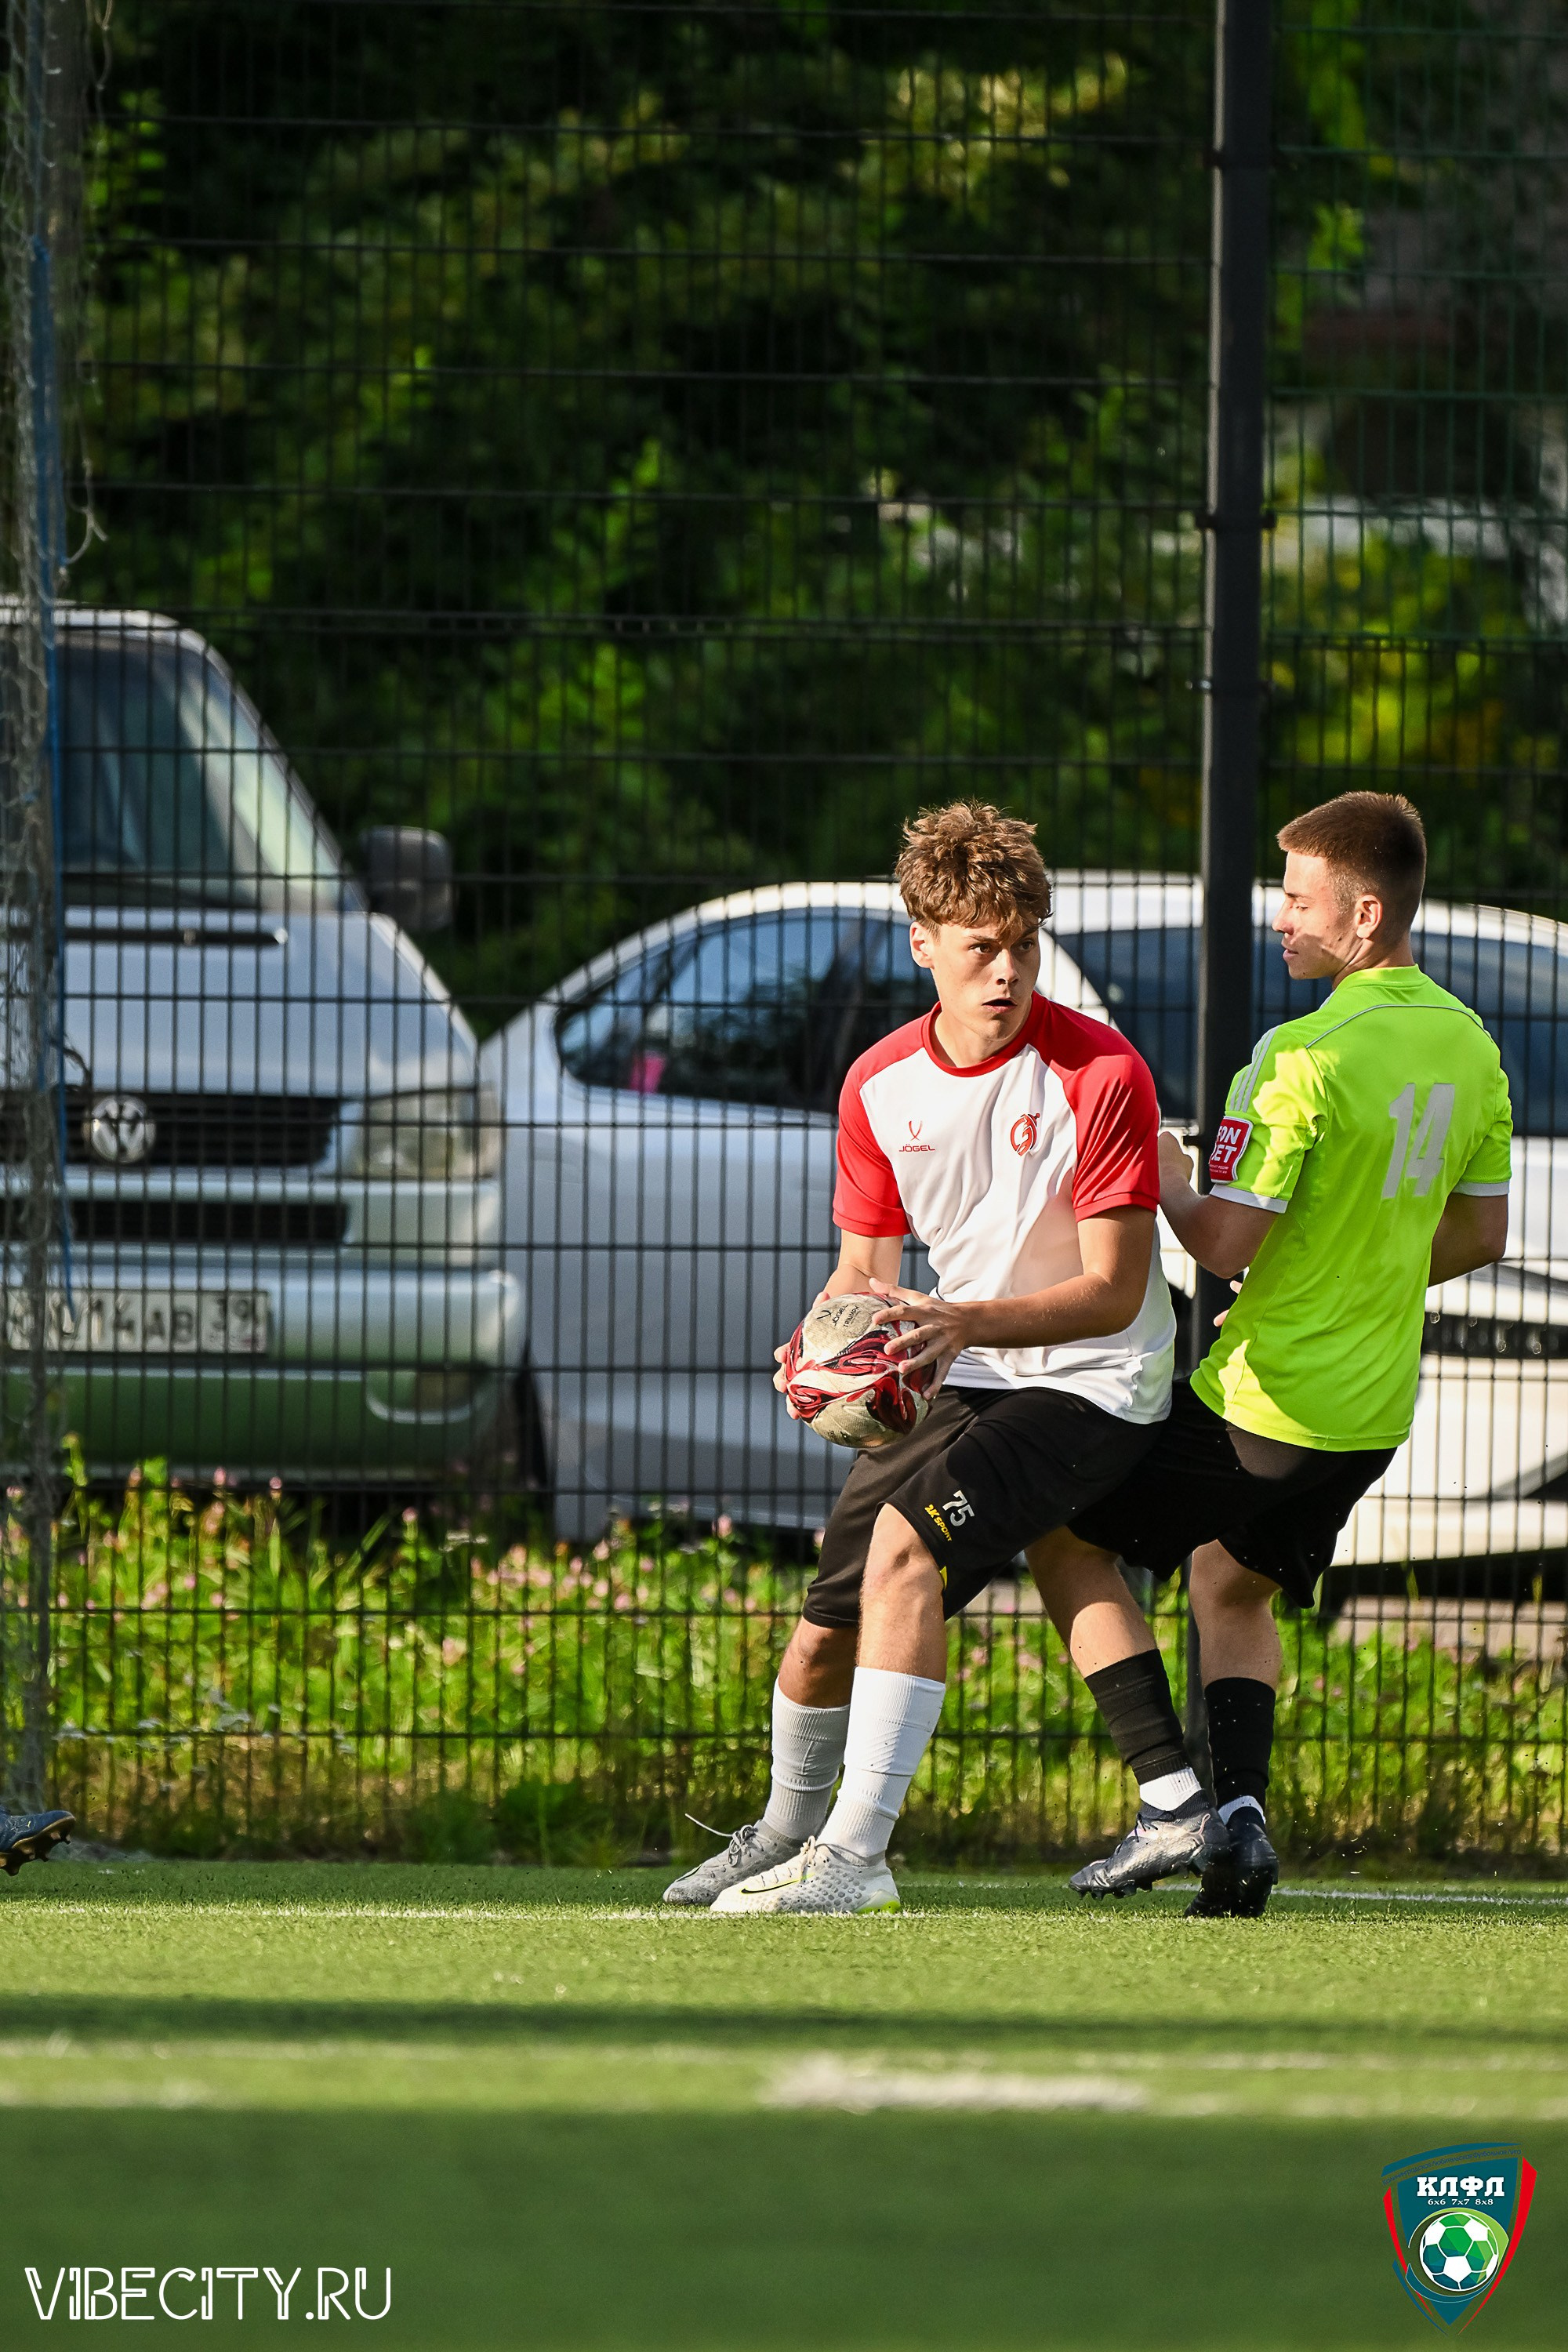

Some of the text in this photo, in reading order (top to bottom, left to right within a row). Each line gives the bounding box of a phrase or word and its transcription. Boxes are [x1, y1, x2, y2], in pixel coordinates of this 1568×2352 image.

[898, 1143, 935, 1152] JÖGEL
[1211, 1144, 1237, 1163] ET
[1388, 1082, 1455, 1199] 14
[924, 1504, 953, 1541] 2K SPORT
[942, 1490, 975, 1526] 75
